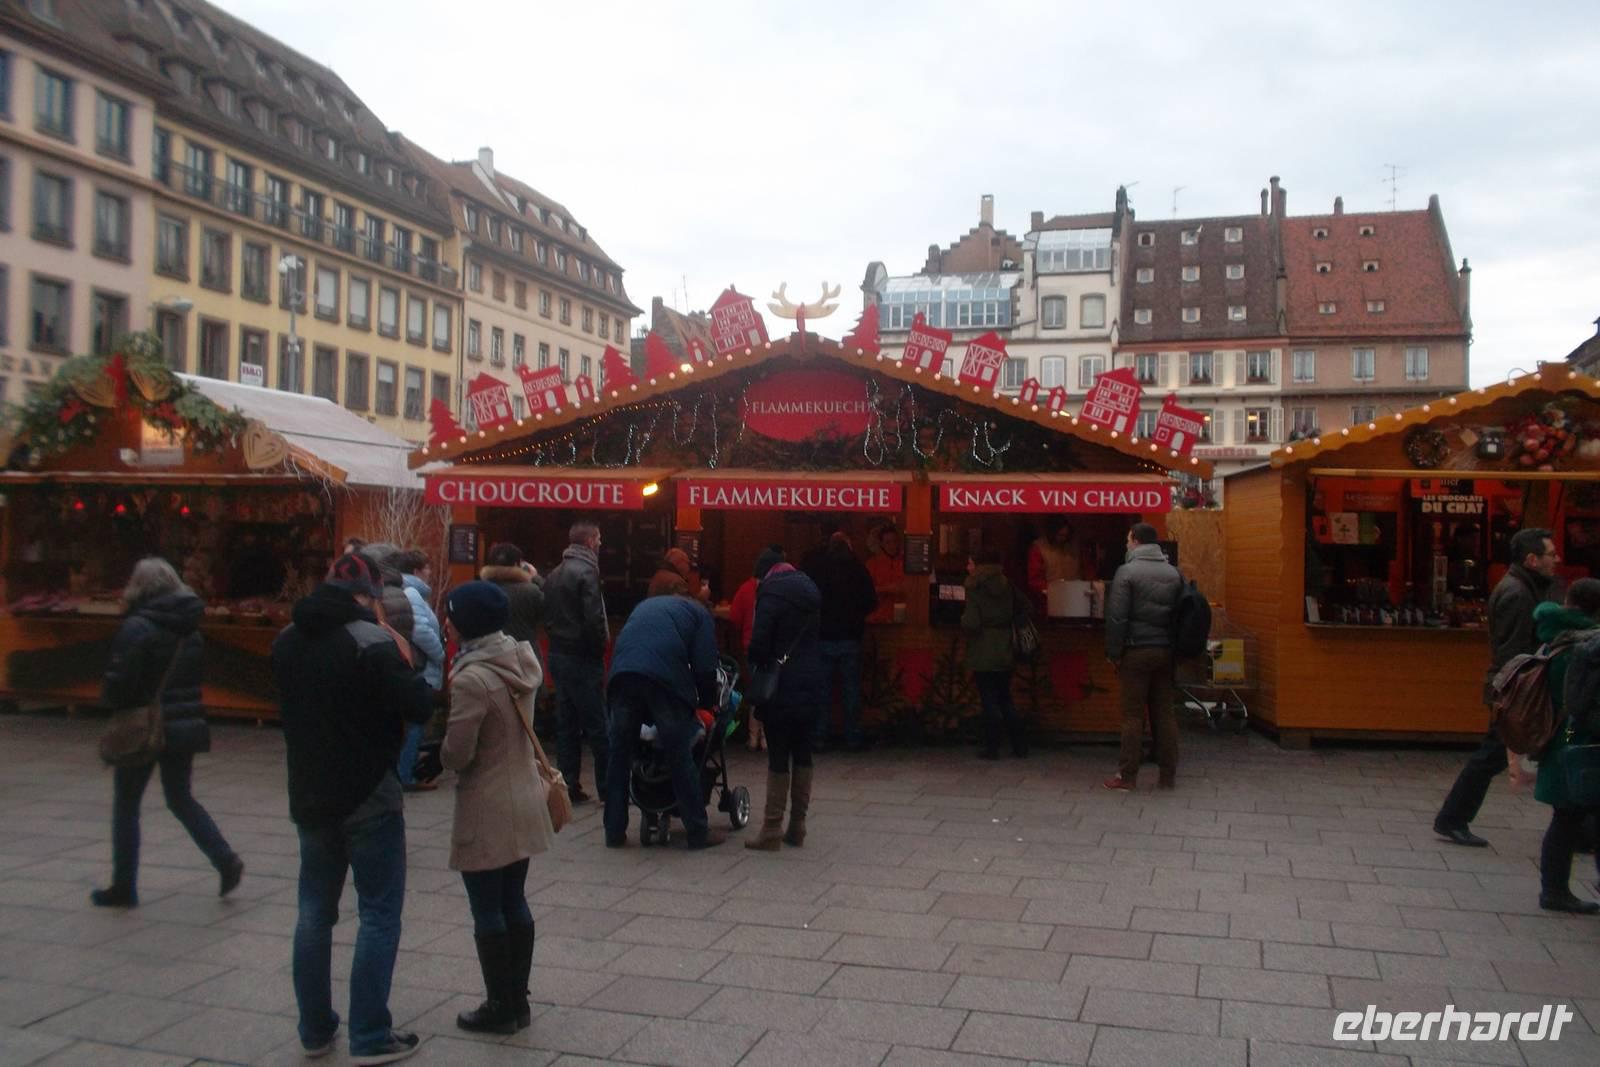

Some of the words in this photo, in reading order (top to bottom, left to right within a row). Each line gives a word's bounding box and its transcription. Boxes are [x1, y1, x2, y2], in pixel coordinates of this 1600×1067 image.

[438, 480, 625, 507] CHOUCROUTE
[688, 485, 891, 509] FLAMMEKUECHE
[948, 488, 1026, 507] KNACK
[1039, 490, 1077, 507] VIN
[1084, 490, 1162, 508] CHAUD
[1422, 502, 1443, 513] DU
[1446, 502, 1485, 514] CHAT
